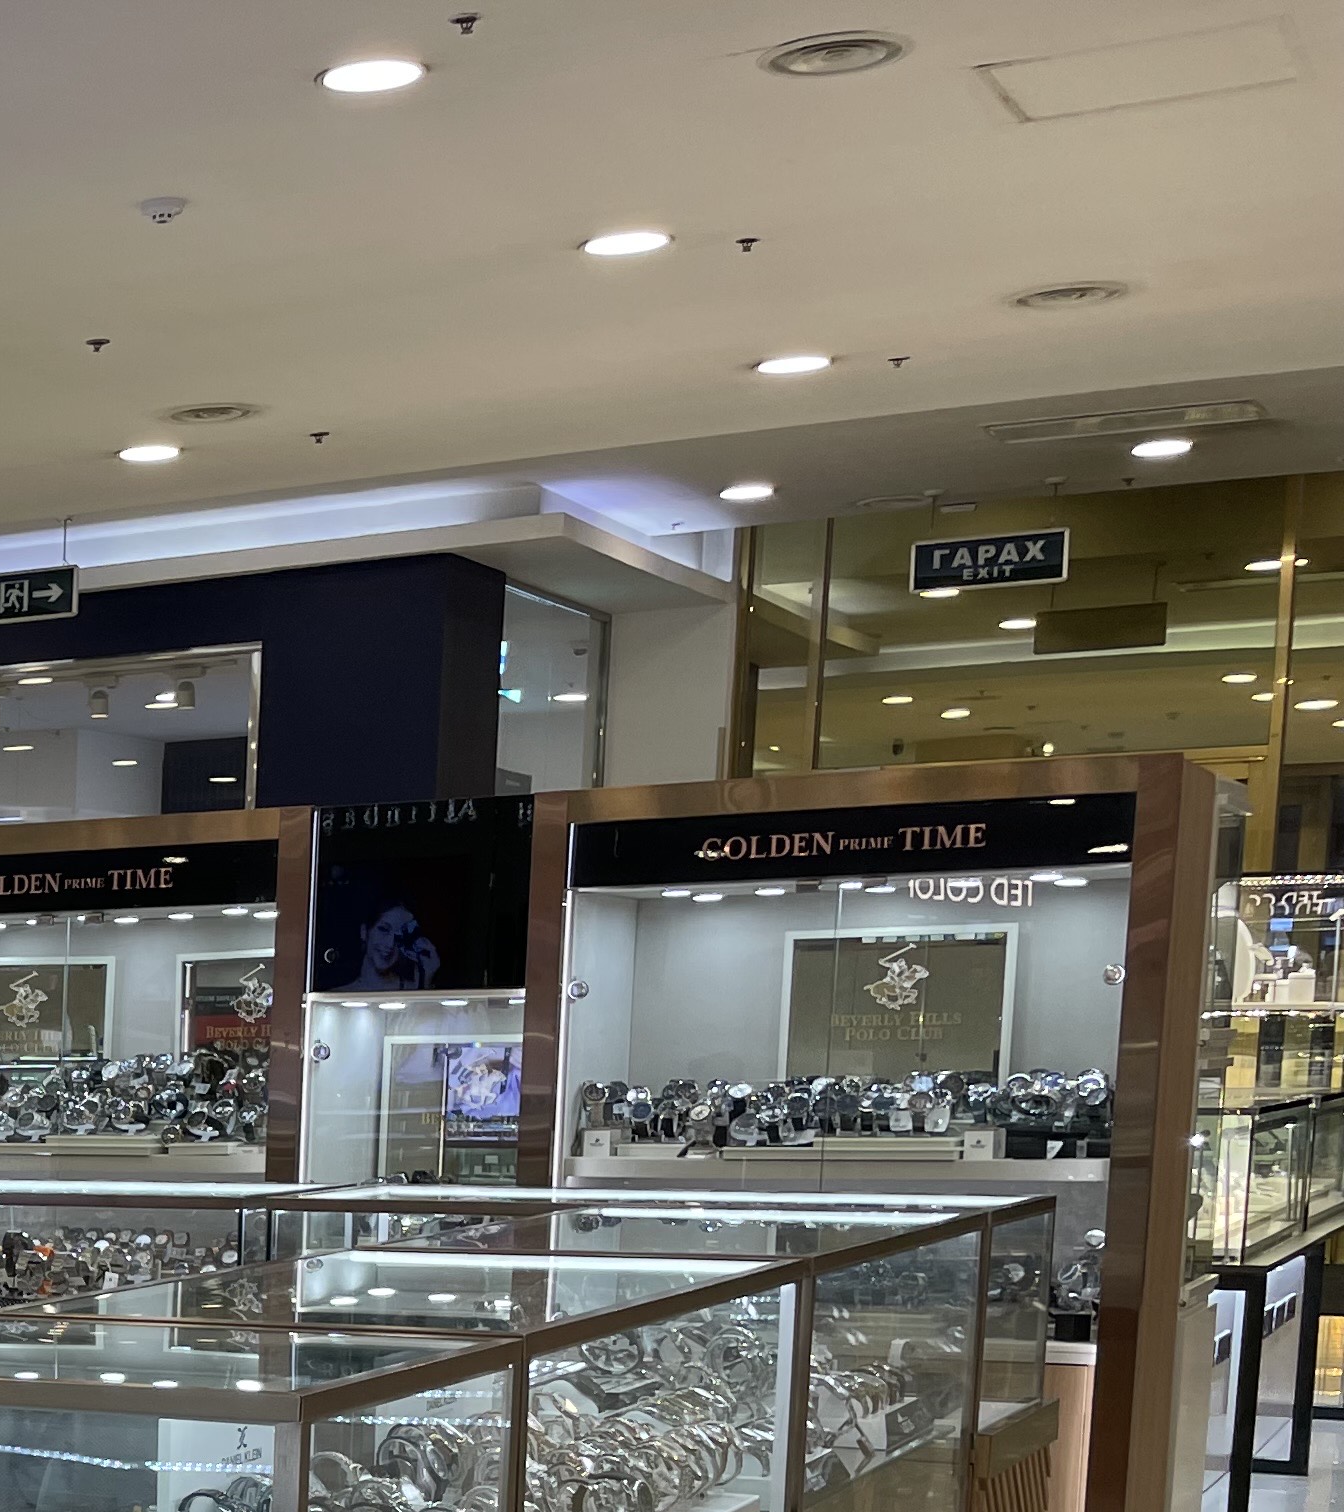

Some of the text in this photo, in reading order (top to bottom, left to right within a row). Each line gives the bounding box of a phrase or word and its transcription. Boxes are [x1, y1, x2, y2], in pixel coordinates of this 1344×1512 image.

[932, 539, 1046, 570] ГАРАХ
[962, 564, 1015, 580] EXIT
[702, 823, 987, 861] GOLDEN PRIME TIME
[64, 877, 105, 890] PRIME
[108, 867, 174, 891] TIME
[831, 1013, 905, 1027] BEVERLY
[206, 1025, 258, 1038] BEVERLY
[846, 1027, 891, 1041] POLO
